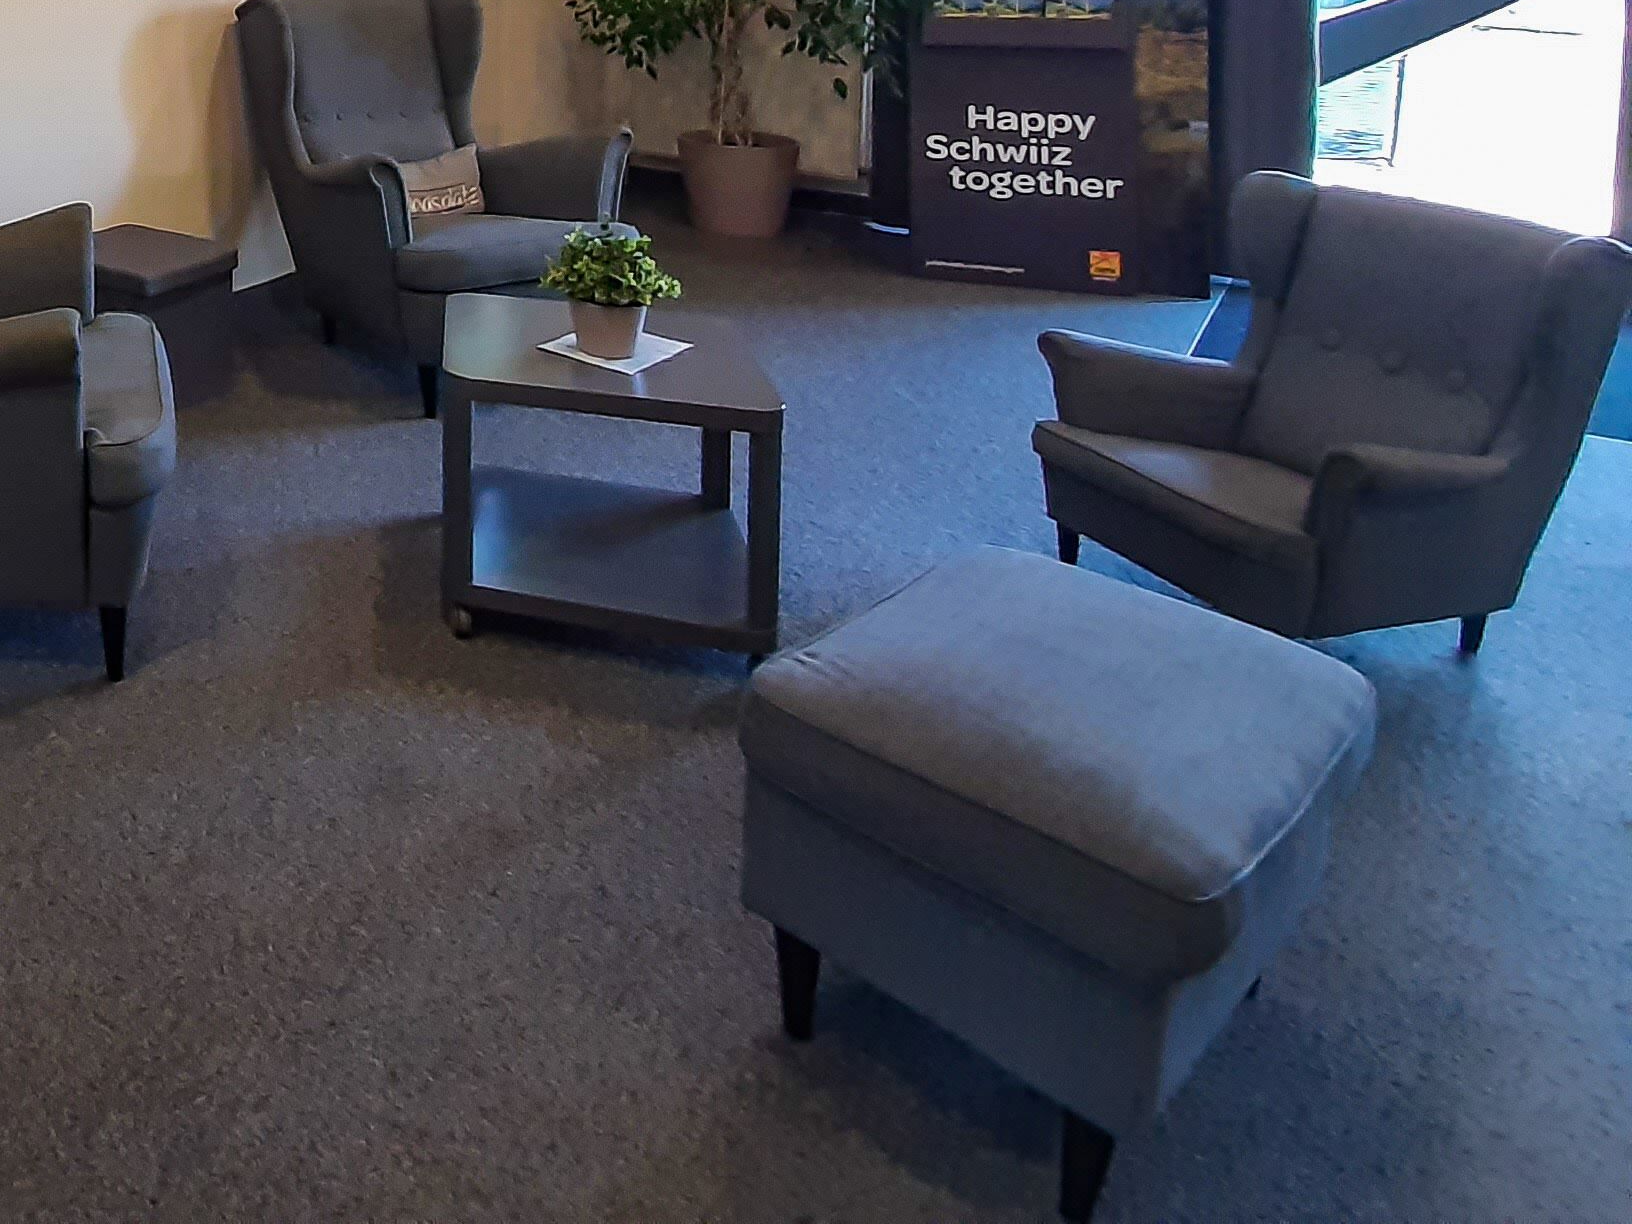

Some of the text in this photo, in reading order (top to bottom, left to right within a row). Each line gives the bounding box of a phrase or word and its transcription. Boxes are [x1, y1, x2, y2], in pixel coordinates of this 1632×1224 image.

[967, 104, 1097, 141] Happy
[925, 134, 1073, 166] Schwiiz
[948, 165, 1125, 200] together
